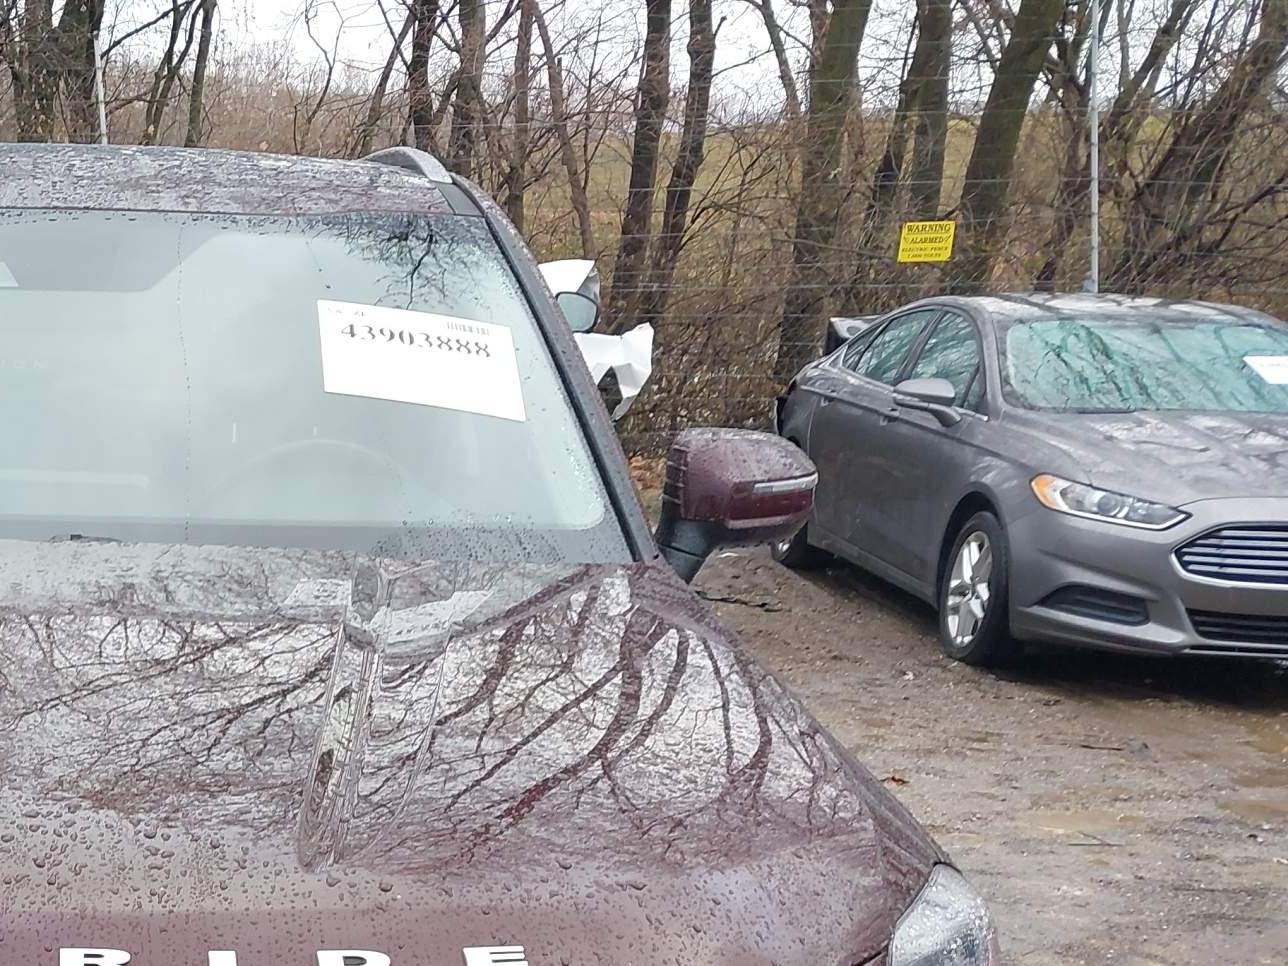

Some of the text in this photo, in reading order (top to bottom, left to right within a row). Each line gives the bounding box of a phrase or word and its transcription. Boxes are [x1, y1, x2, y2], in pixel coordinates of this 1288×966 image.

[906, 223, 951, 233] WARNING
[910, 236, 944, 244] ALARMED
[340, 322, 492, 360] 43903888
